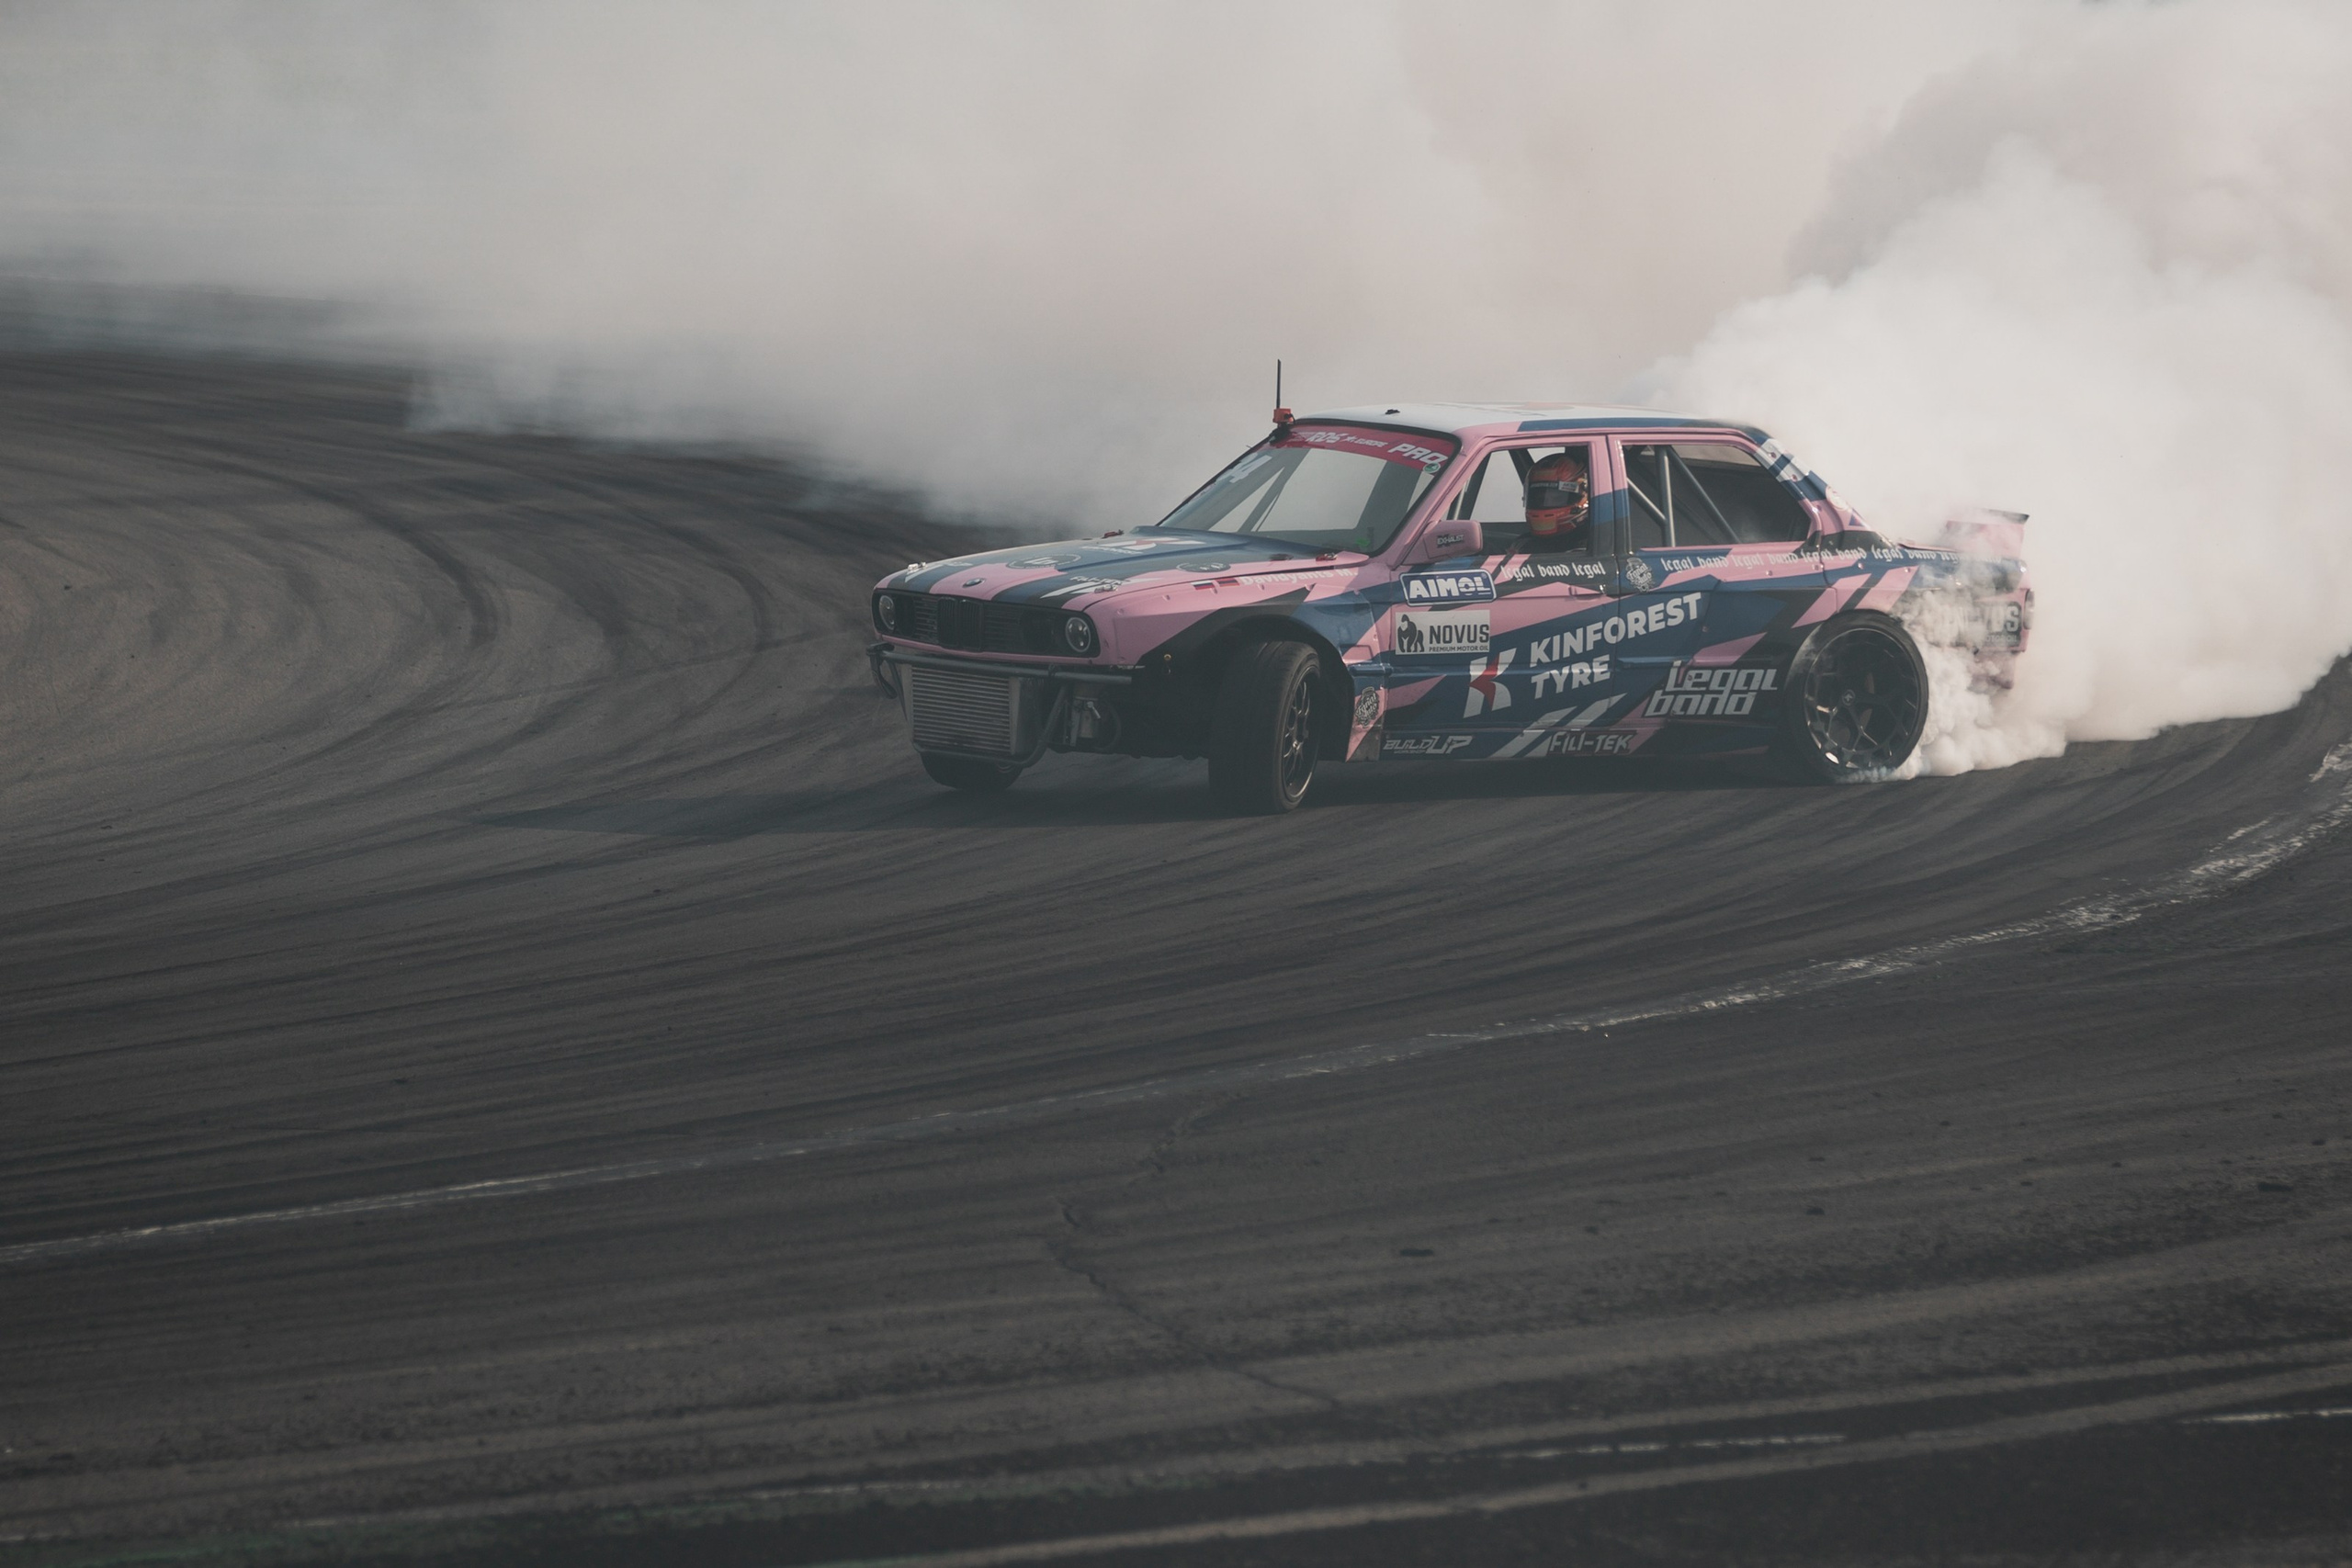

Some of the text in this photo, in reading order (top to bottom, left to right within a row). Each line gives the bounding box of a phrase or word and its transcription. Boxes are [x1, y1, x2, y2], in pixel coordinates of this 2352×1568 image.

[1387, 442, 1449, 465] PRO
[1660, 556, 1695, 573] legal
[1696, 555, 1729, 569] band
[1730, 554, 1765, 570] legal
[1766, 552, 1799, 565] band
[1835, 547, 1868, 560] band
[1871, 544, 1904, 562] legal
[1335, 568, 1358, 577] M.
[1499, 560, 1606, 581] legal band legal
[1408, 576, 1491, 599] AIMOL
[1429, 624, 1489, 645] NOVUS
[1530, 592, 1702, 668] KINFOREST
[1531, 654, 1611, 700] TYRE
[1549, 731, 1634, 754] FILI-TEK
